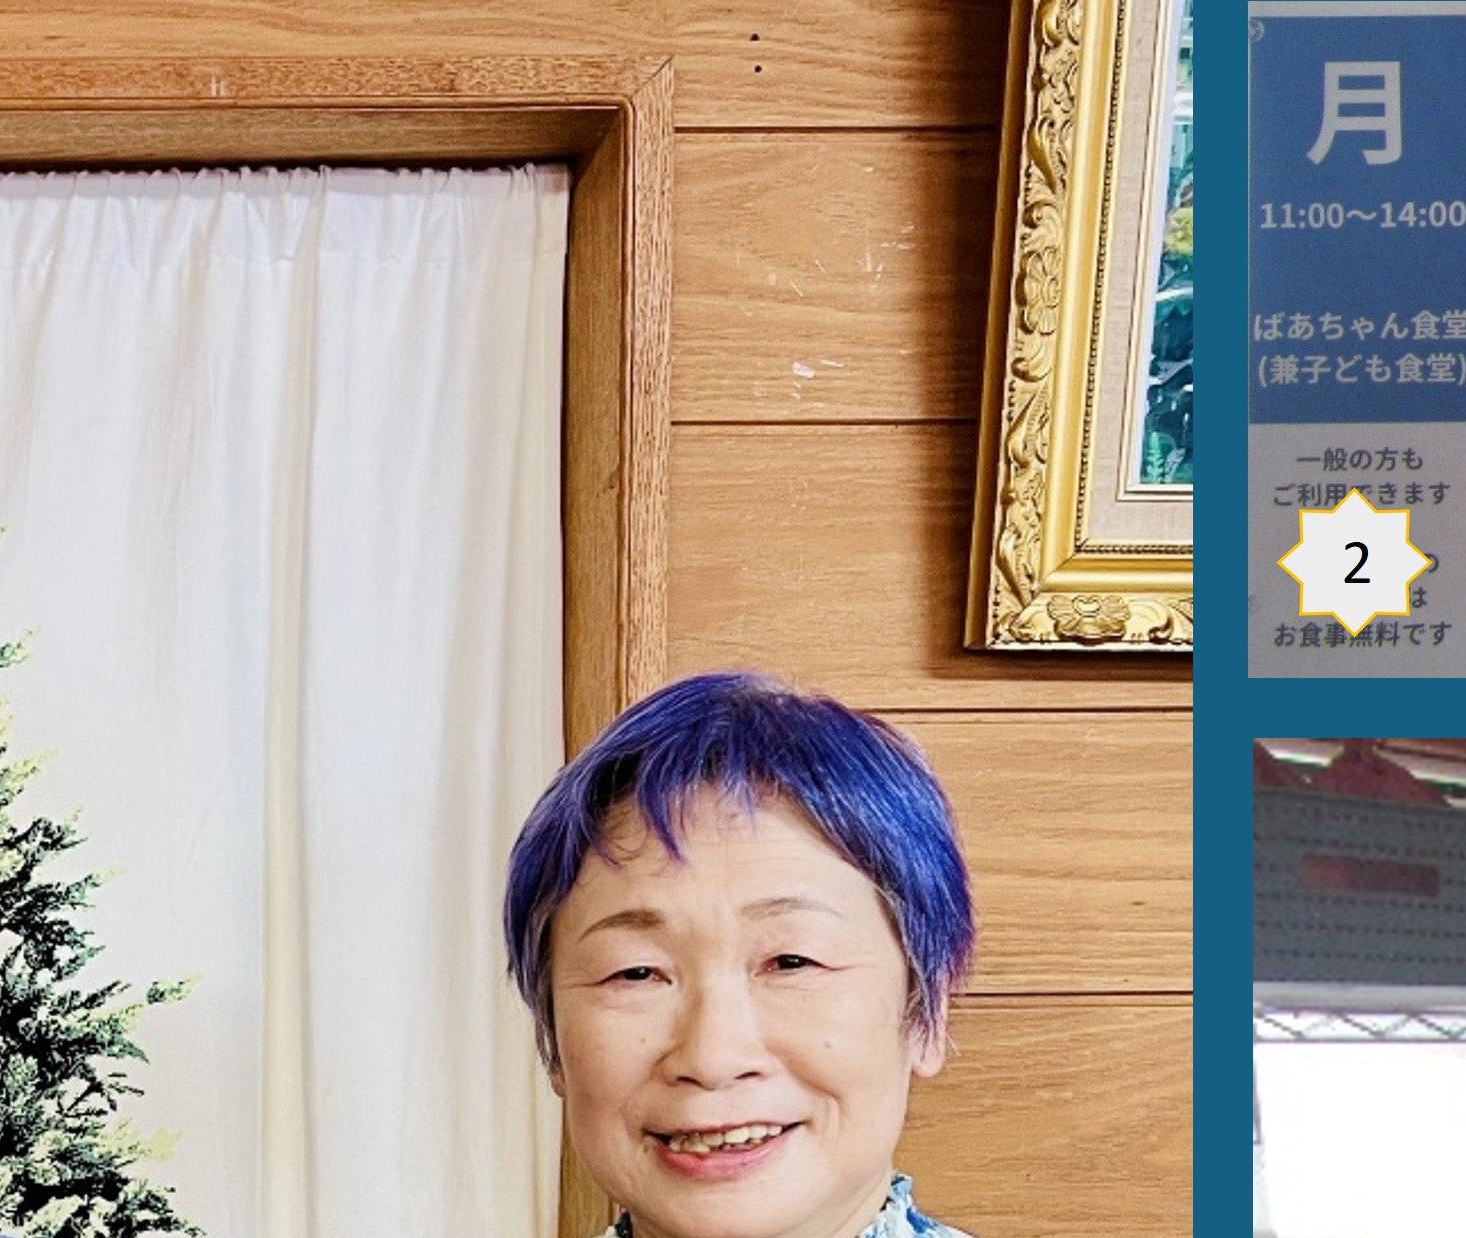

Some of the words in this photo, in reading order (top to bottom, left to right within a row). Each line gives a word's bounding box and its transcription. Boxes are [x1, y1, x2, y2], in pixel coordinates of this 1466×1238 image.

[1308, 62, 1401, 164] 月
[1259, 353, 1466, 387] (兼子ども食堂)
[1297, 447, 1423, 471] 一般の方も
